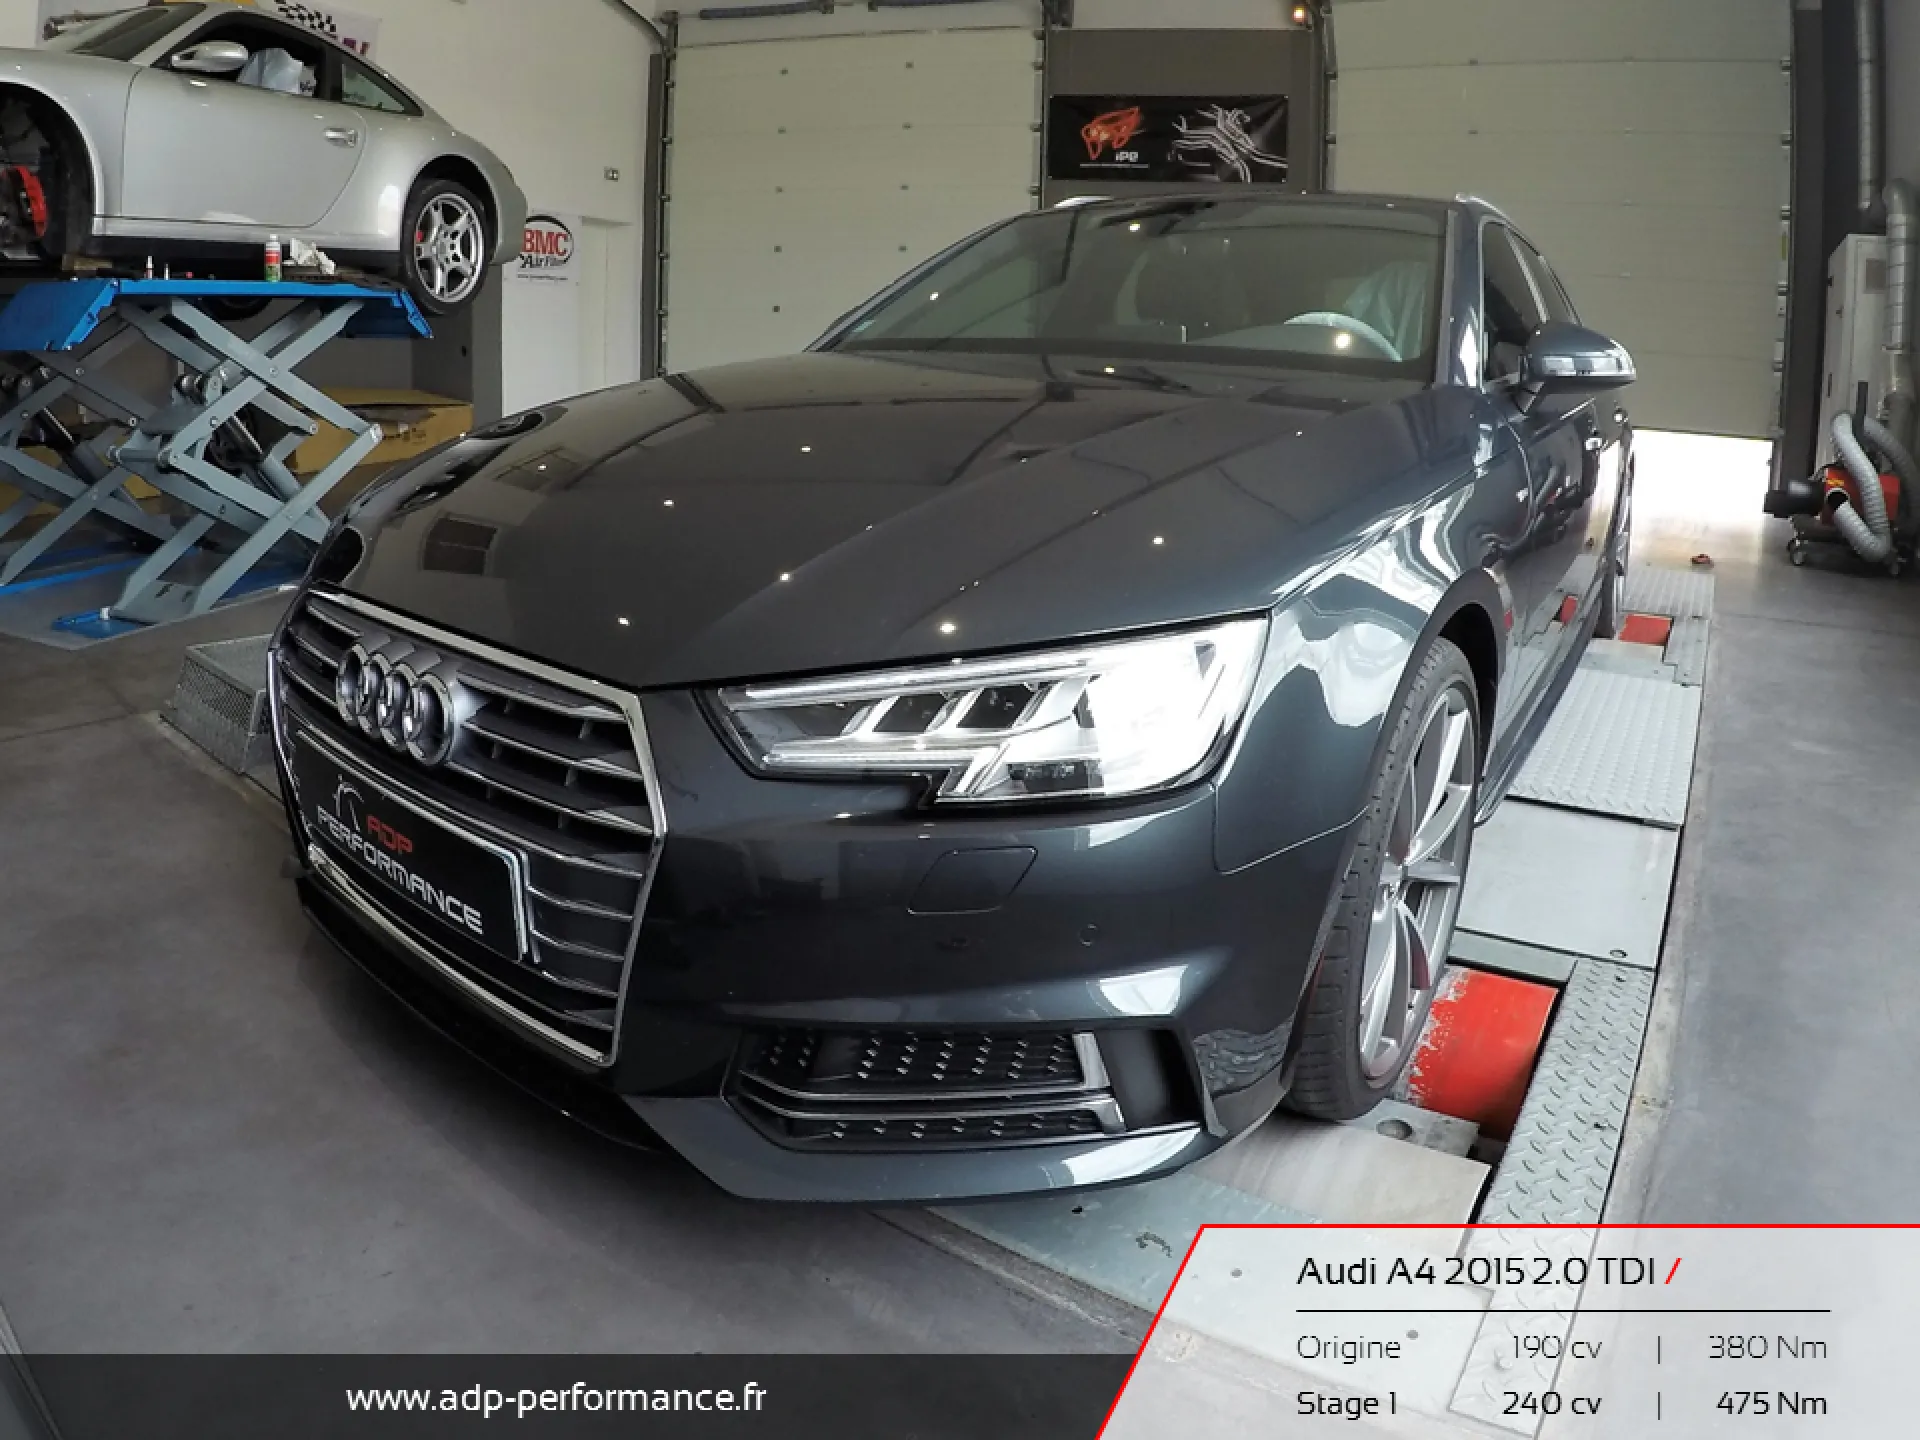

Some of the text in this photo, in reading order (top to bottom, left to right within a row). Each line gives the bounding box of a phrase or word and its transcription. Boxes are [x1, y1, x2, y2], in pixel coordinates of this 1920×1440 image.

[522, 228, 569, 256] BMC
[367, 815, 413, 853] ADP
[317, 805, 483, 935] PERFORMANCE
